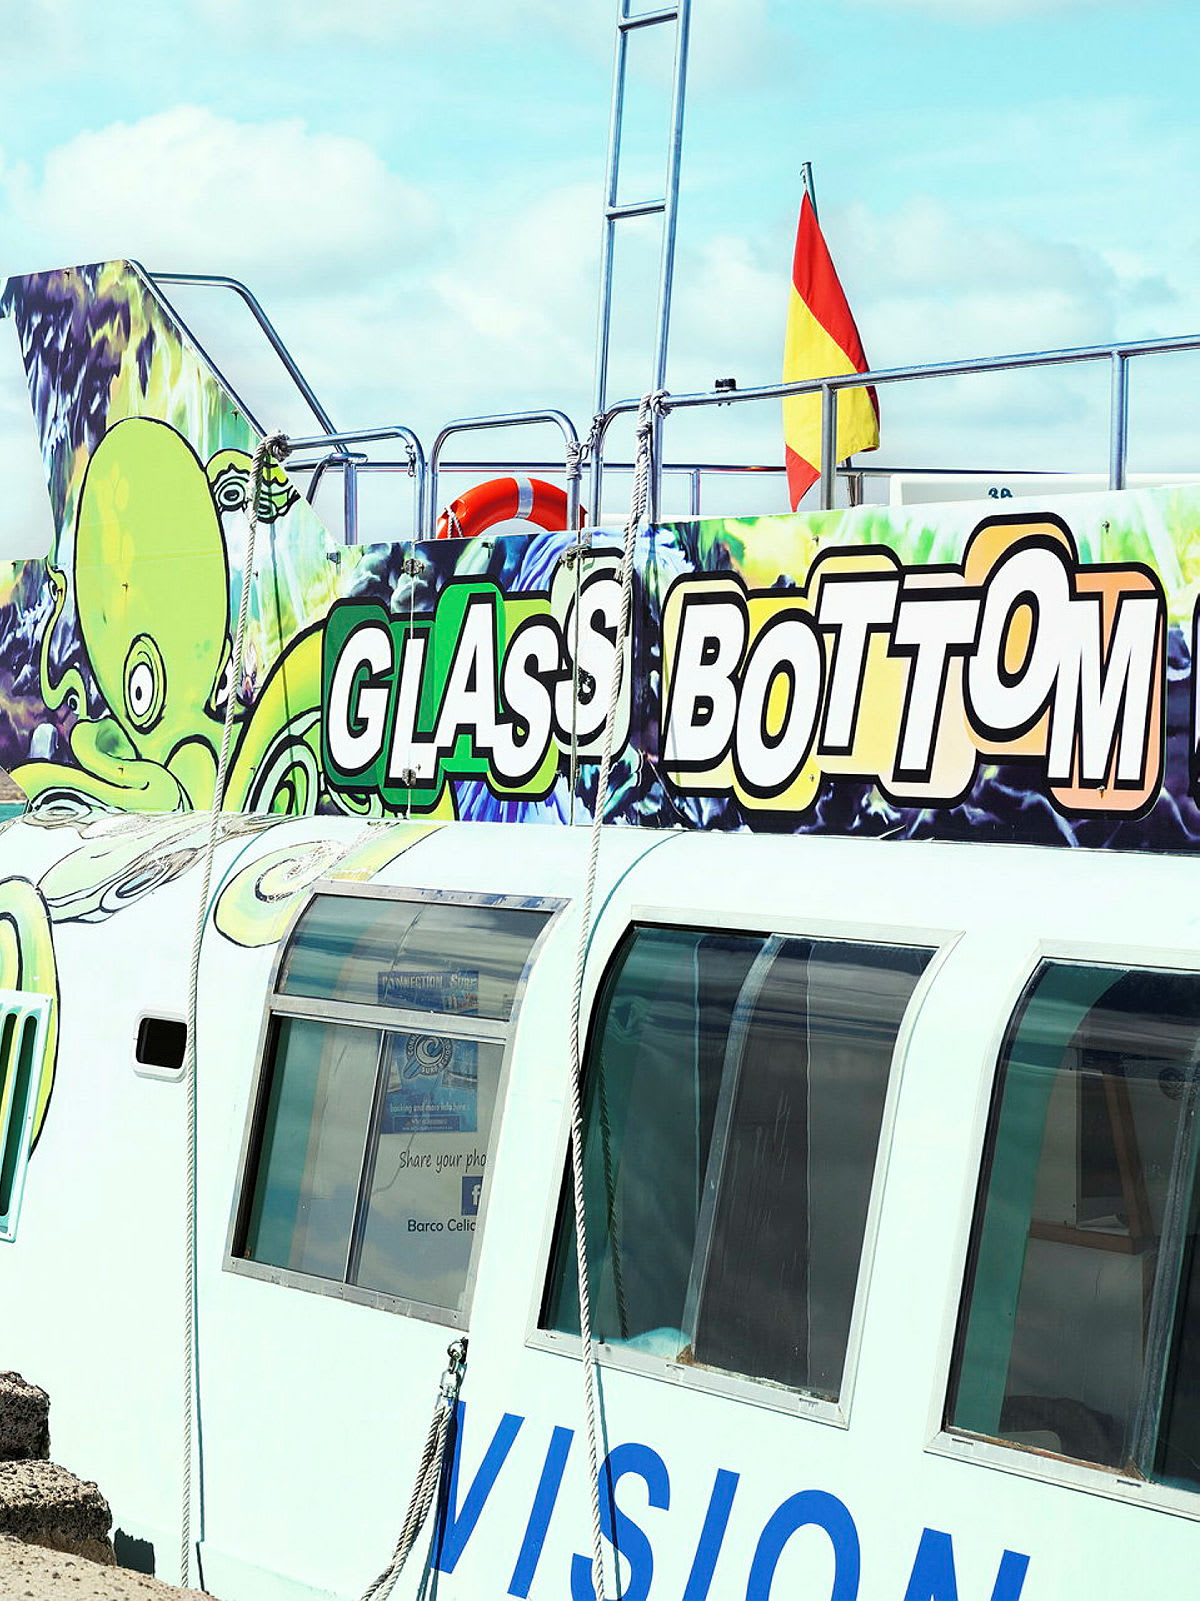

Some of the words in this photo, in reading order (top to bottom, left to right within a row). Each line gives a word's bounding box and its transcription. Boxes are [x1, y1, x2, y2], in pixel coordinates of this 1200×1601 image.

[326, 567, 630, 790] GLASS
[660, 530, 1164, 798] BOTTOM
[399, 1150, 432, 1169] Share
[436, 1154, 462, 1174] your
[407, 1219, 444, 1232] Barco
